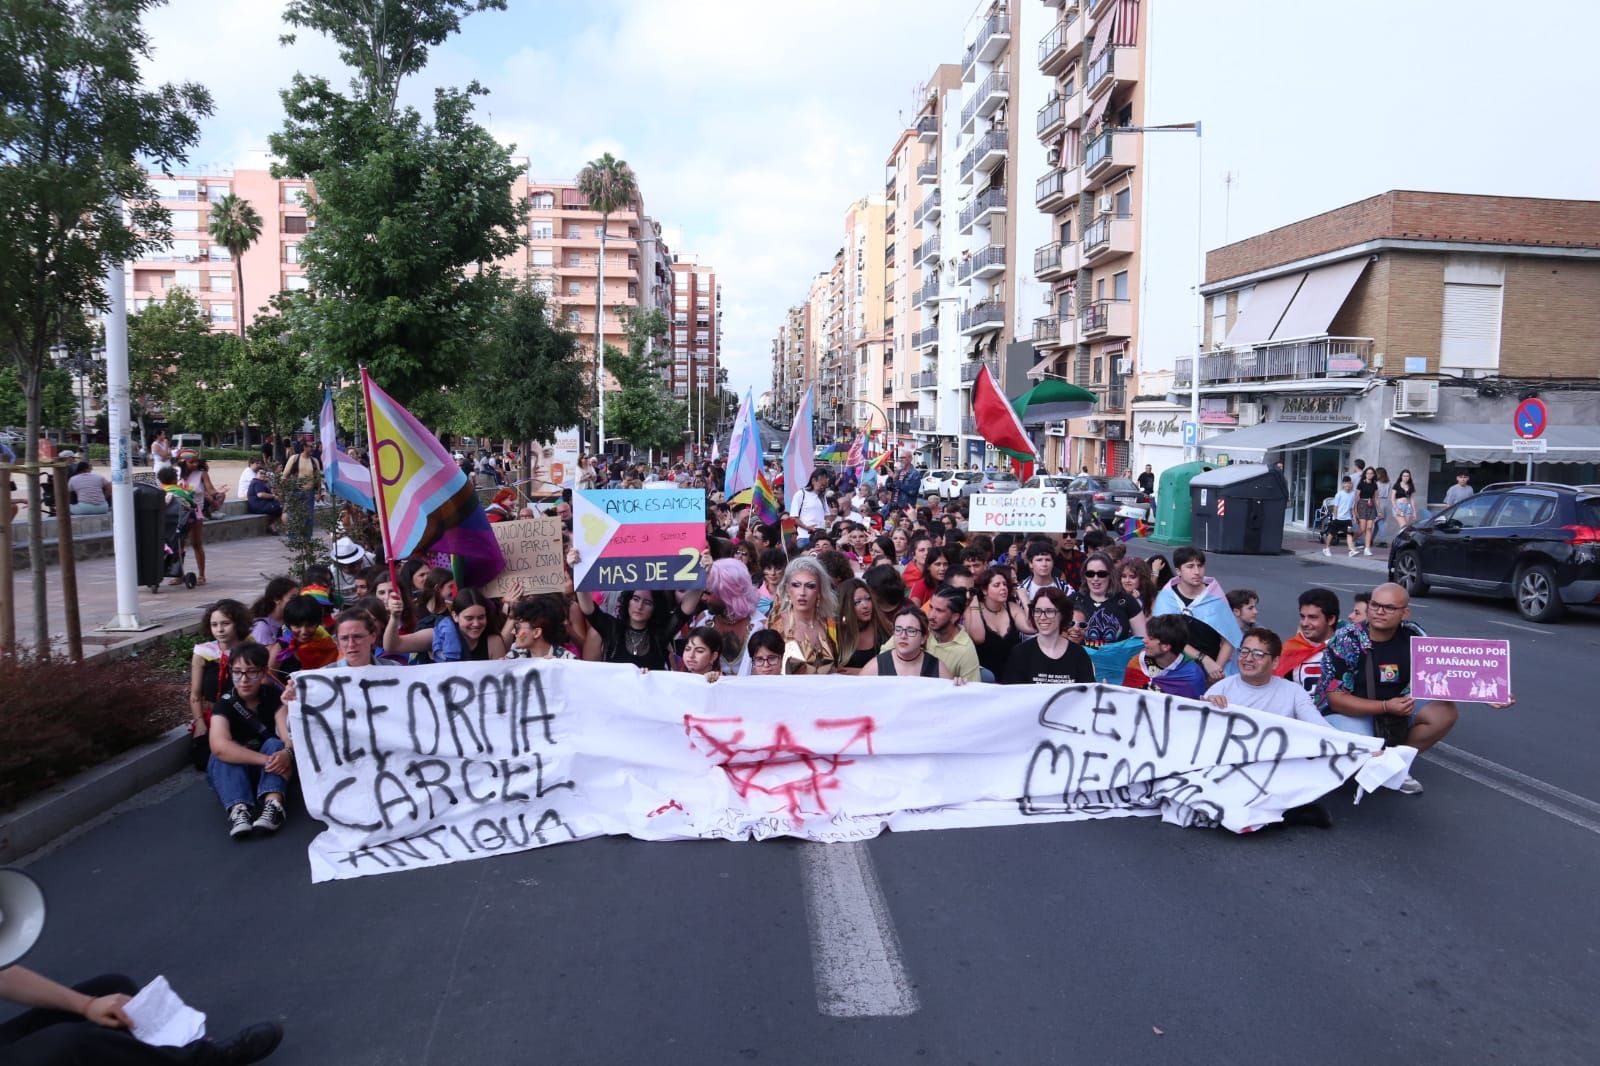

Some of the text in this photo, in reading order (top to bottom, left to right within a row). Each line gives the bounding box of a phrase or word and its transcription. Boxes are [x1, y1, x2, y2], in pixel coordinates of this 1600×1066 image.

[1185, 424, 1194, 443] P
[645, 499, 660, 511] ES
[976, 497, 987, 506] EL
[1041, 497, 1056, 508] ES
[985, 508, 1046, 527] POLÍTICO
[493, 520, 556, 540] ONOMBRES
[521, 540, 549, 553] PARA
[599, 547, 699, 584] MAS DE 2
[1418, 645, 1506, 656] HOY MARCHO POR
[1425, 657, 1433, 665] SI
[1436, 657, 1480, 667] MAÑANA
[1447, 670, 1477, 678] ESTOY
[300, 668, 557, 772] REFORMA
[322, 752, 576, 831] CARCEL
[338, 808, 577, 868] ANTIGUA
